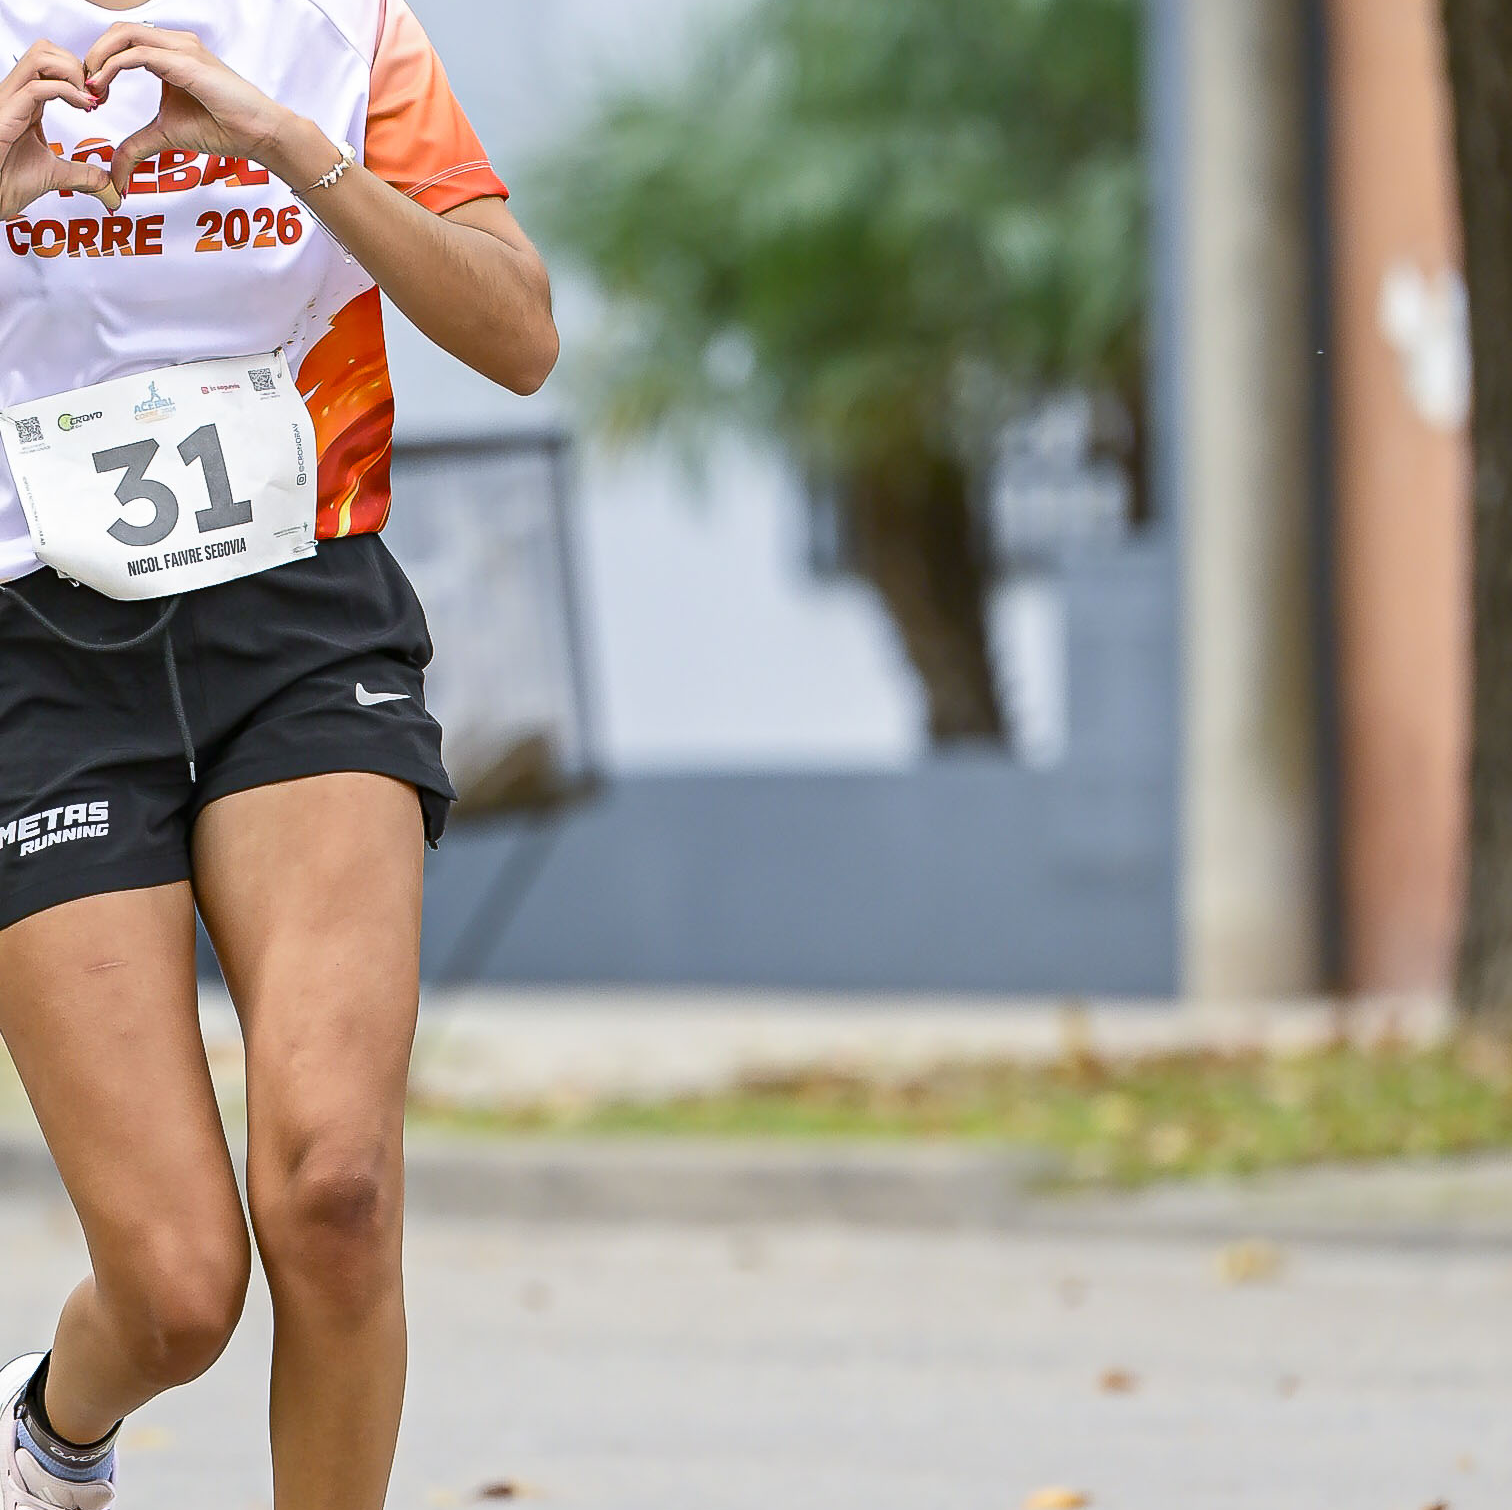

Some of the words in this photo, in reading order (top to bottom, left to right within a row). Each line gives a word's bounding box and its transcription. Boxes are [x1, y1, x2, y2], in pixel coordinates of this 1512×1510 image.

[5, 214, 165, 258] CORRE
[194, 205, 303, 253] 2026
[92, 423, 253, 547] 31
[127, 556, 163, 577] NICOL
[164, 547, 203, 569] FAIVRE
[204, 537, 247, 561] SEGOVIA
[20, 823, 109, 857] RUNNING
